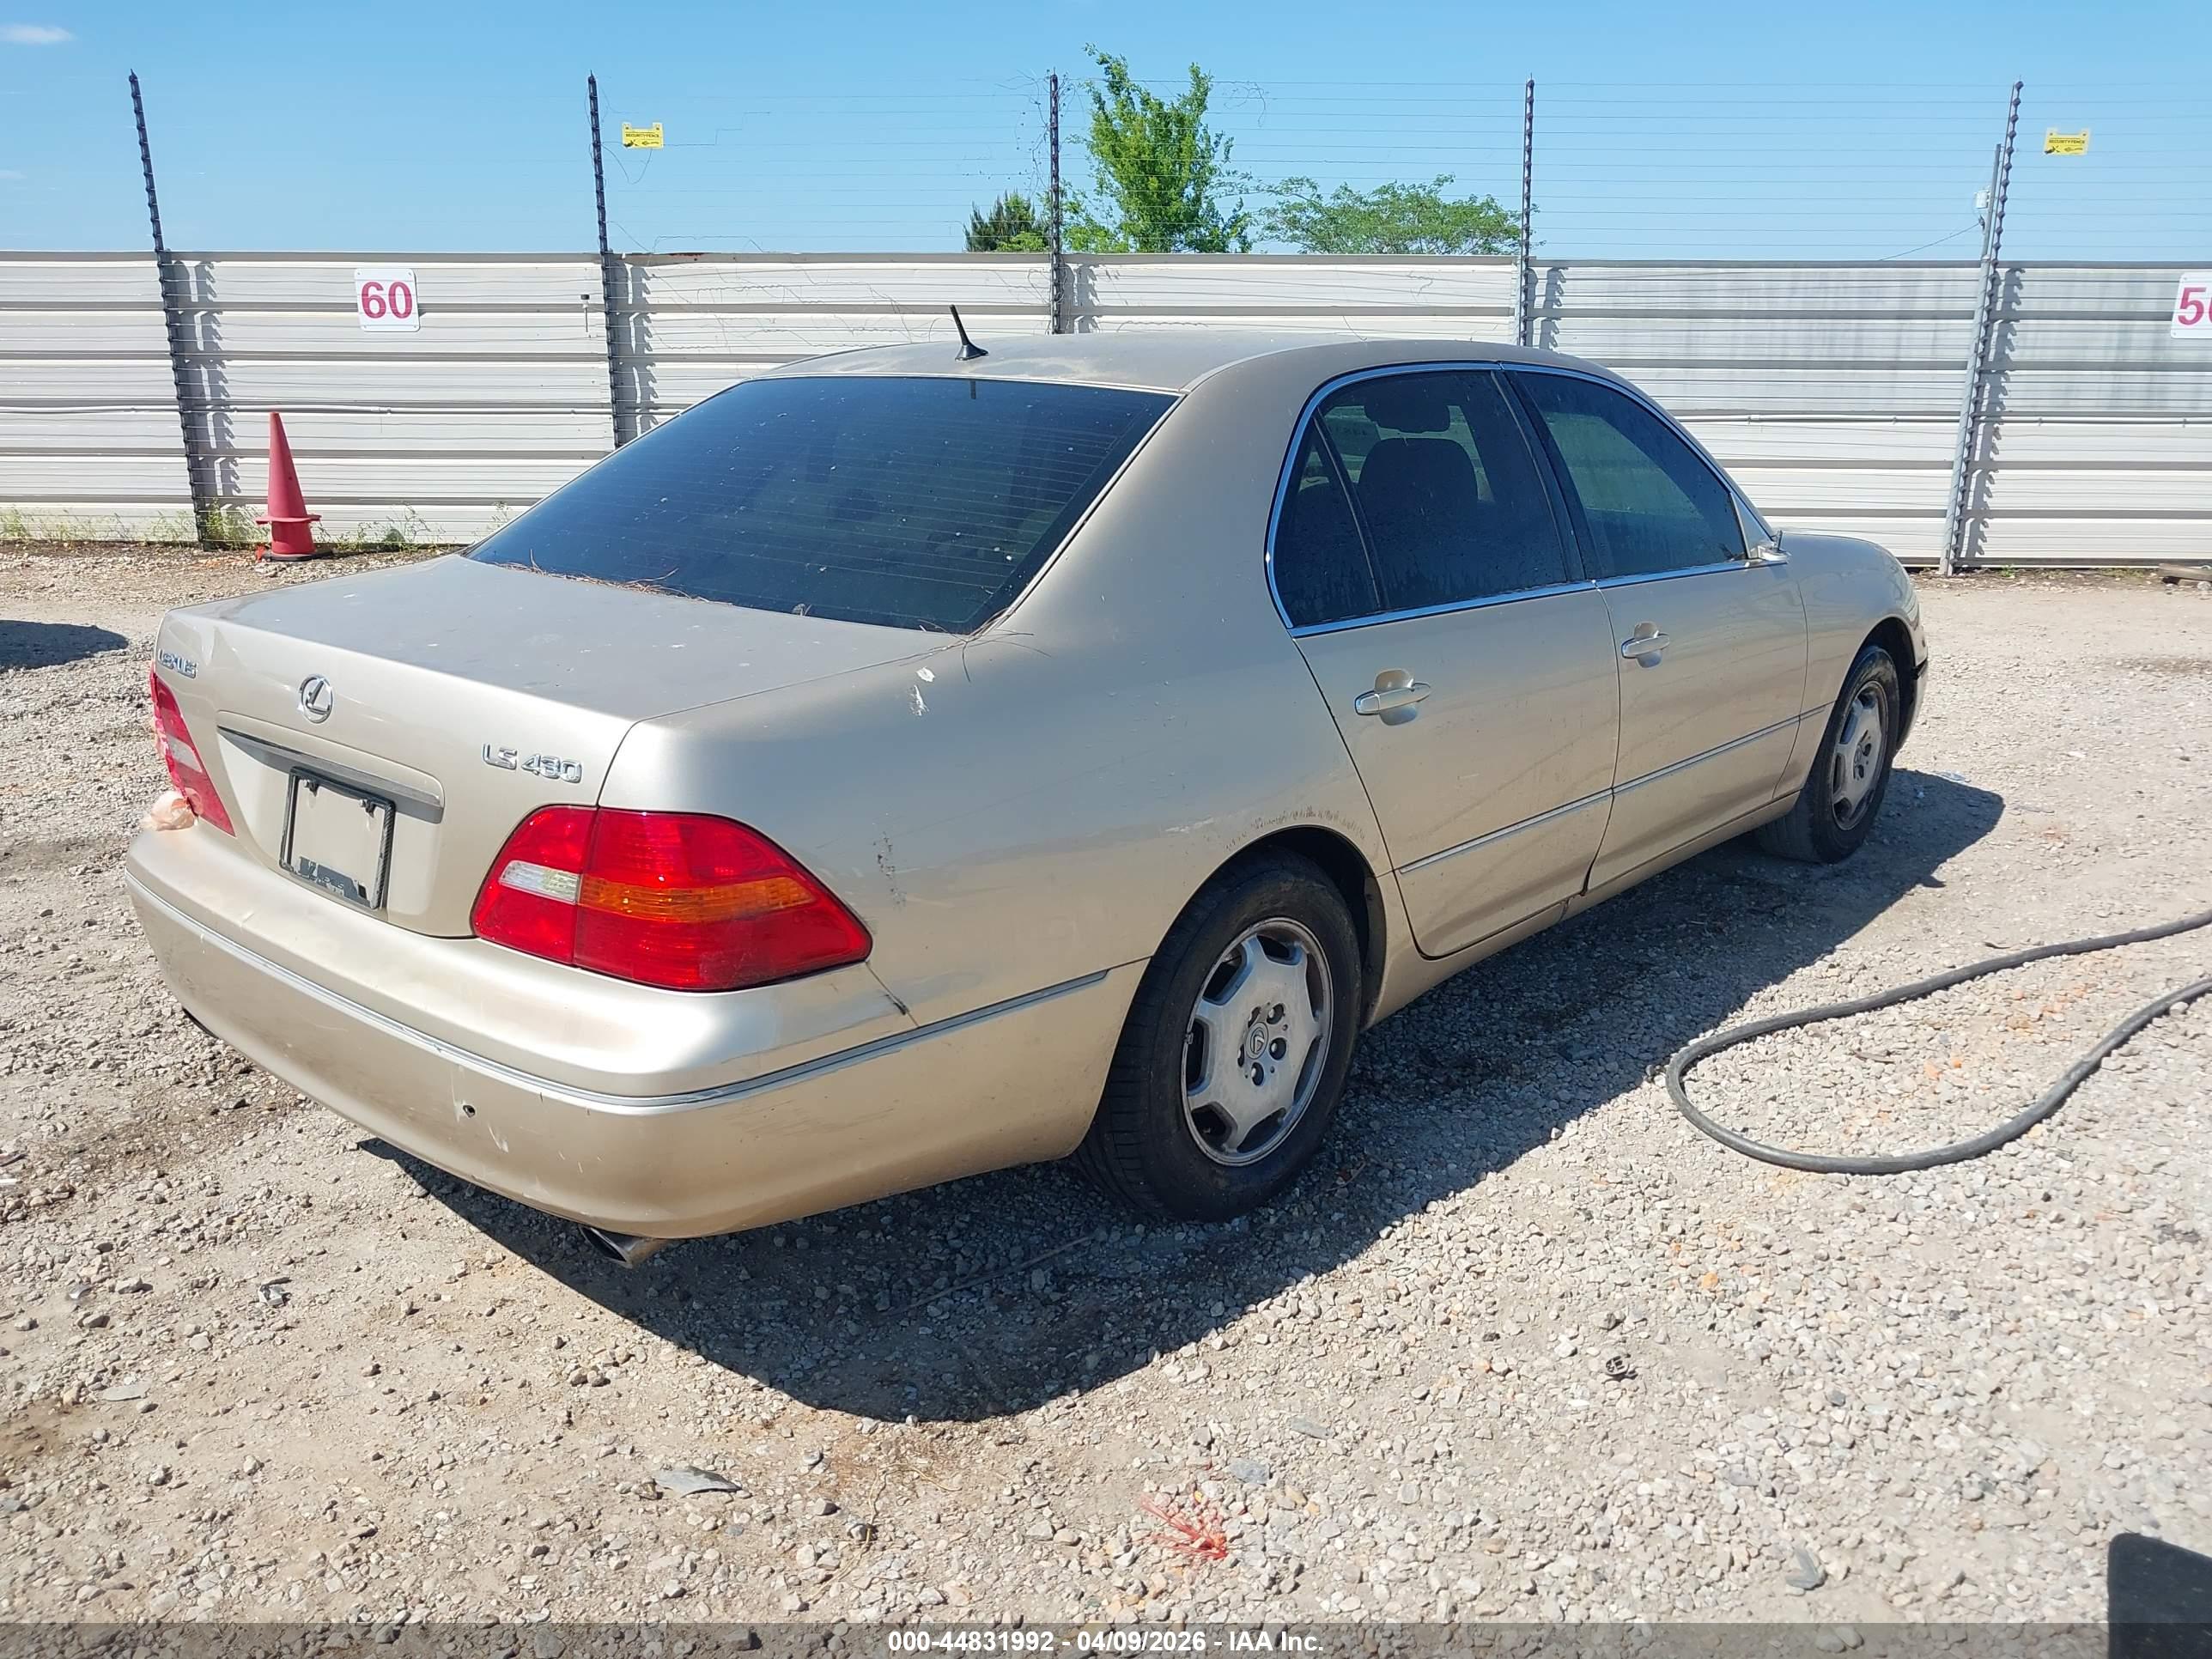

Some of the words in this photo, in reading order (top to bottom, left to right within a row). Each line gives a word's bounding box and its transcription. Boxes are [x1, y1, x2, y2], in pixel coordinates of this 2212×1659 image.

[361, 281, 413, 319] 60
[2177, 287, 2212, 325] 5
[157, 648, 198, 679] LEXUS
[482, 743, 518, 770] LS
[521, 753, 583, 784] 430
